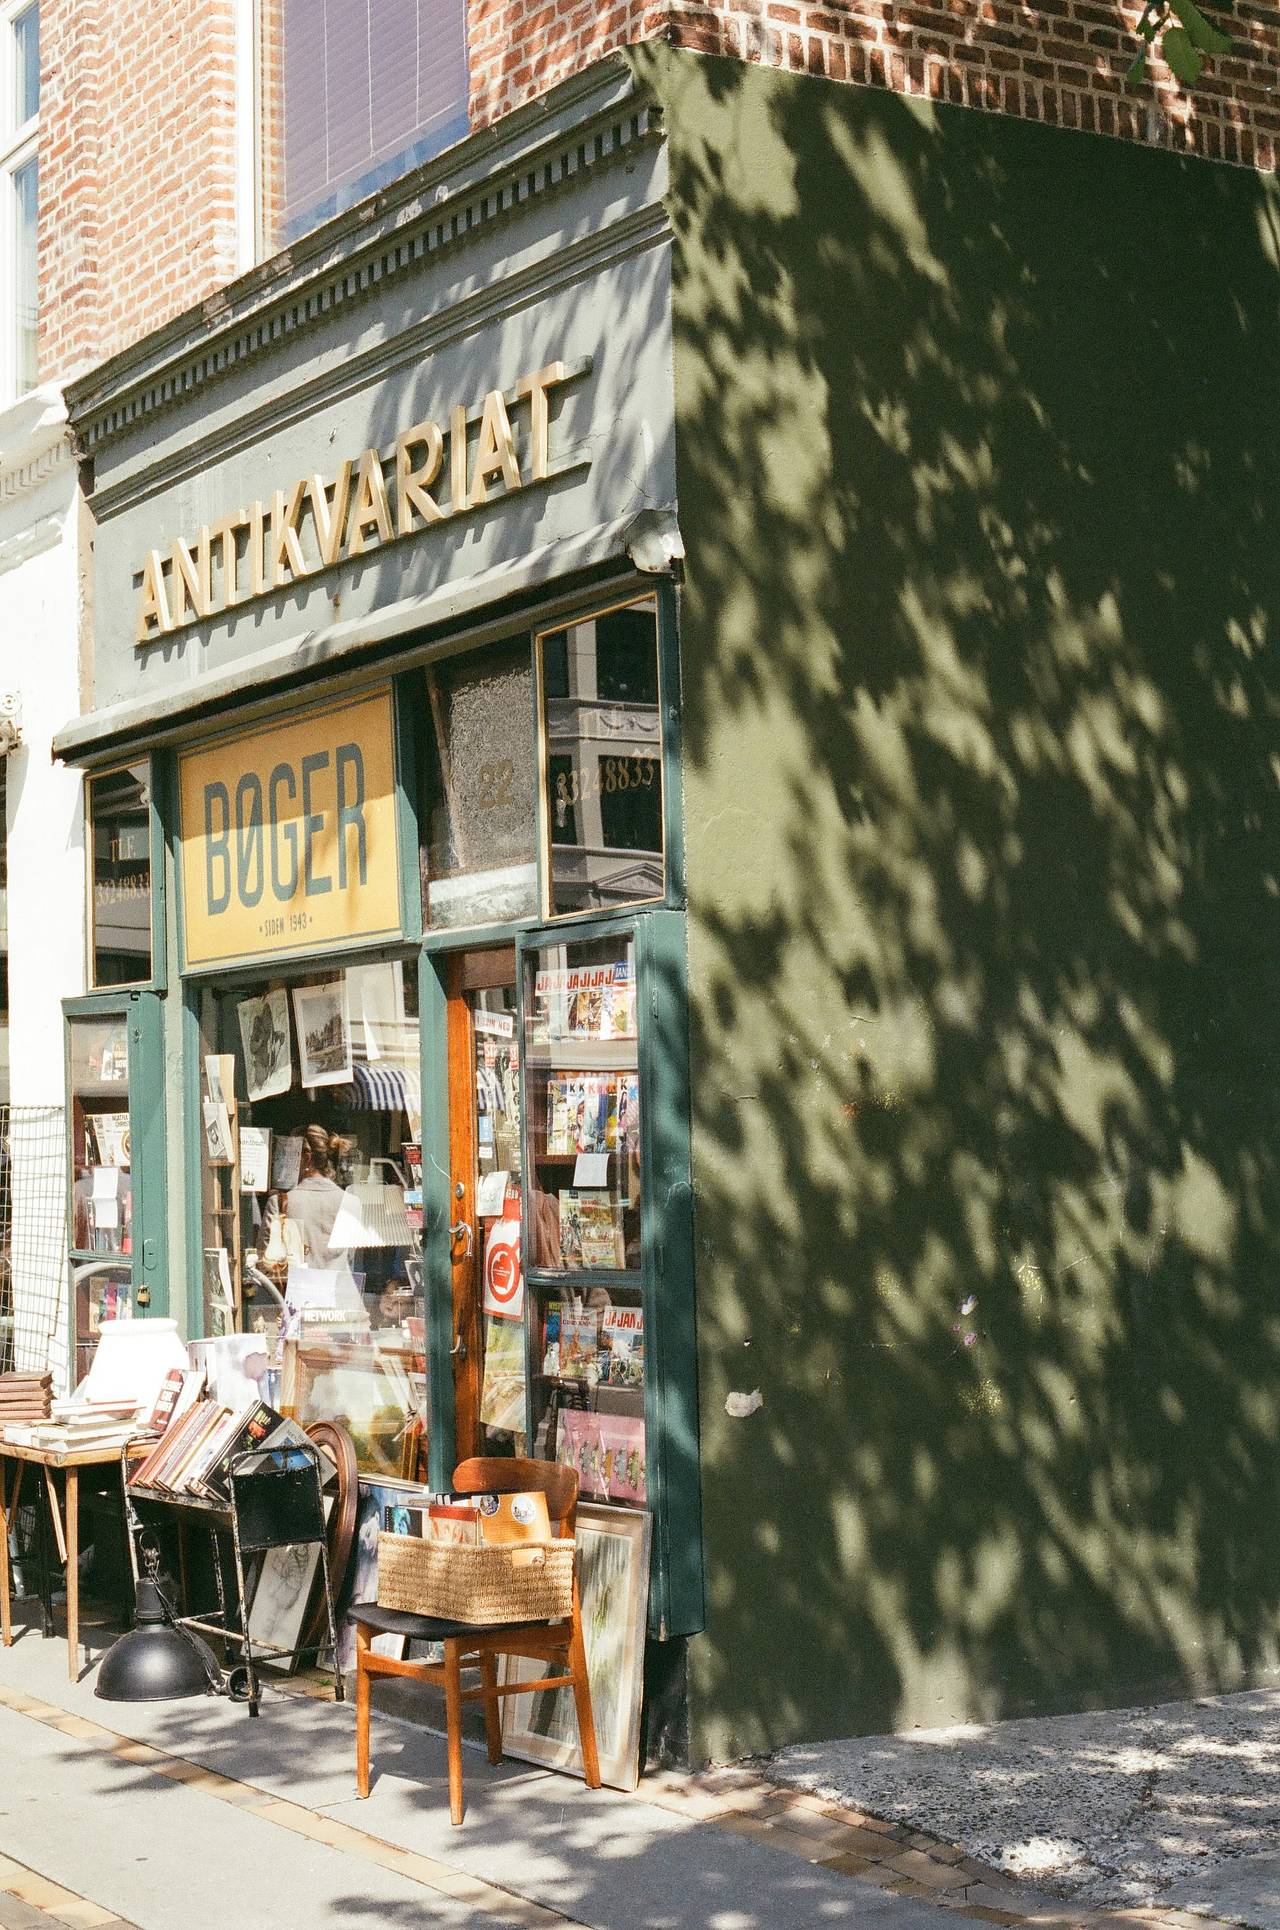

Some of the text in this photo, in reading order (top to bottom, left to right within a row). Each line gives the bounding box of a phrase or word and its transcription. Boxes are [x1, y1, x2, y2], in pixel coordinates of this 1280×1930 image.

[136, 361, 564, 644] ANTIKVARIAT
[204, 742, 367, 916] BØGER
[264, 911, 307, 937] SIDEN 1943
[304, 1309, 346, 1322] NETWORK
